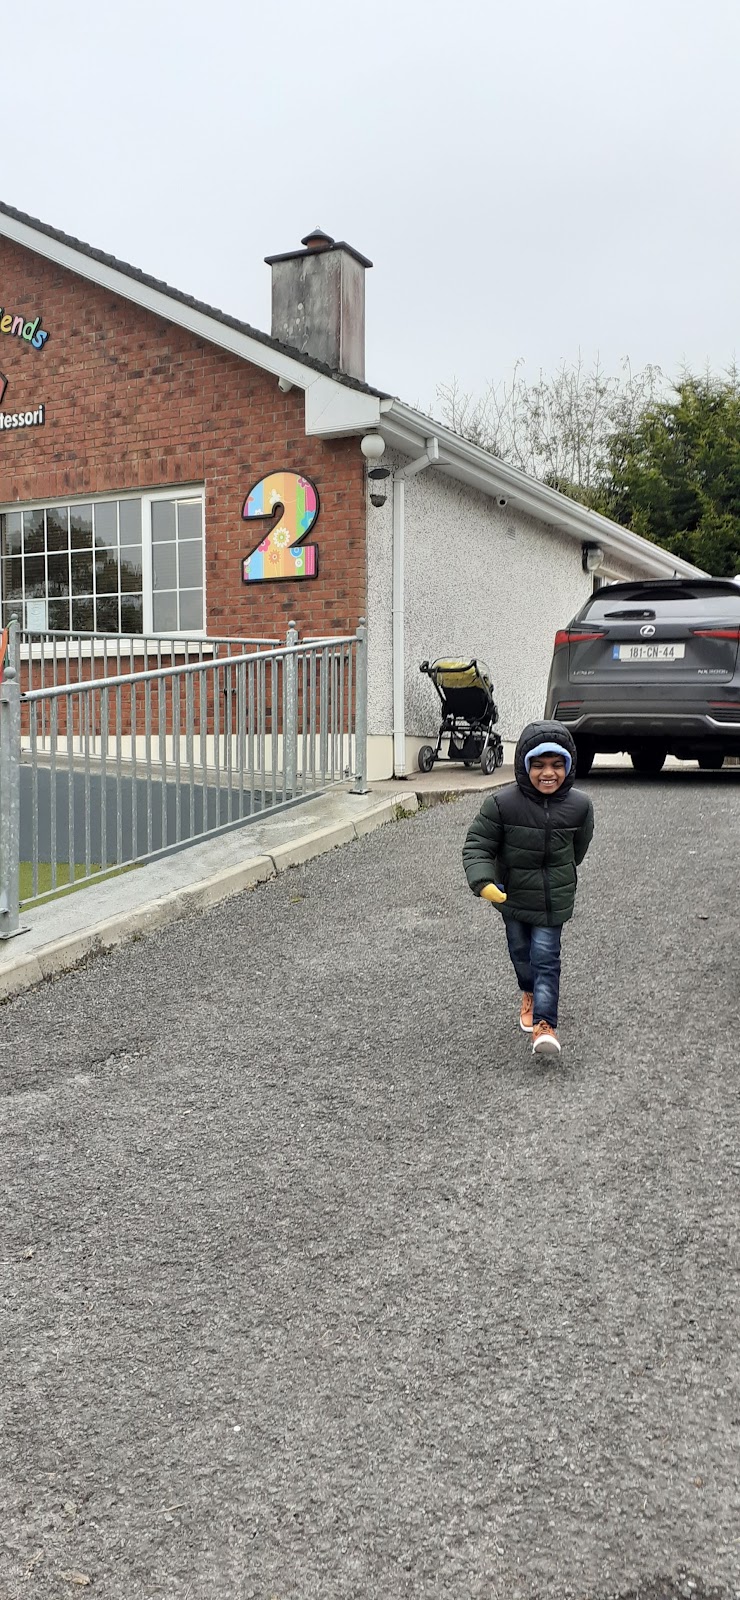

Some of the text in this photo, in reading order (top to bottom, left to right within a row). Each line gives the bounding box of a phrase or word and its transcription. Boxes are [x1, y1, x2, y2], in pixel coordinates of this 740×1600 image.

[0, 308, 49, 349] ends
[242, 471, 320, 583] 2
[630, 646, 675, 658] 181-CN-44
